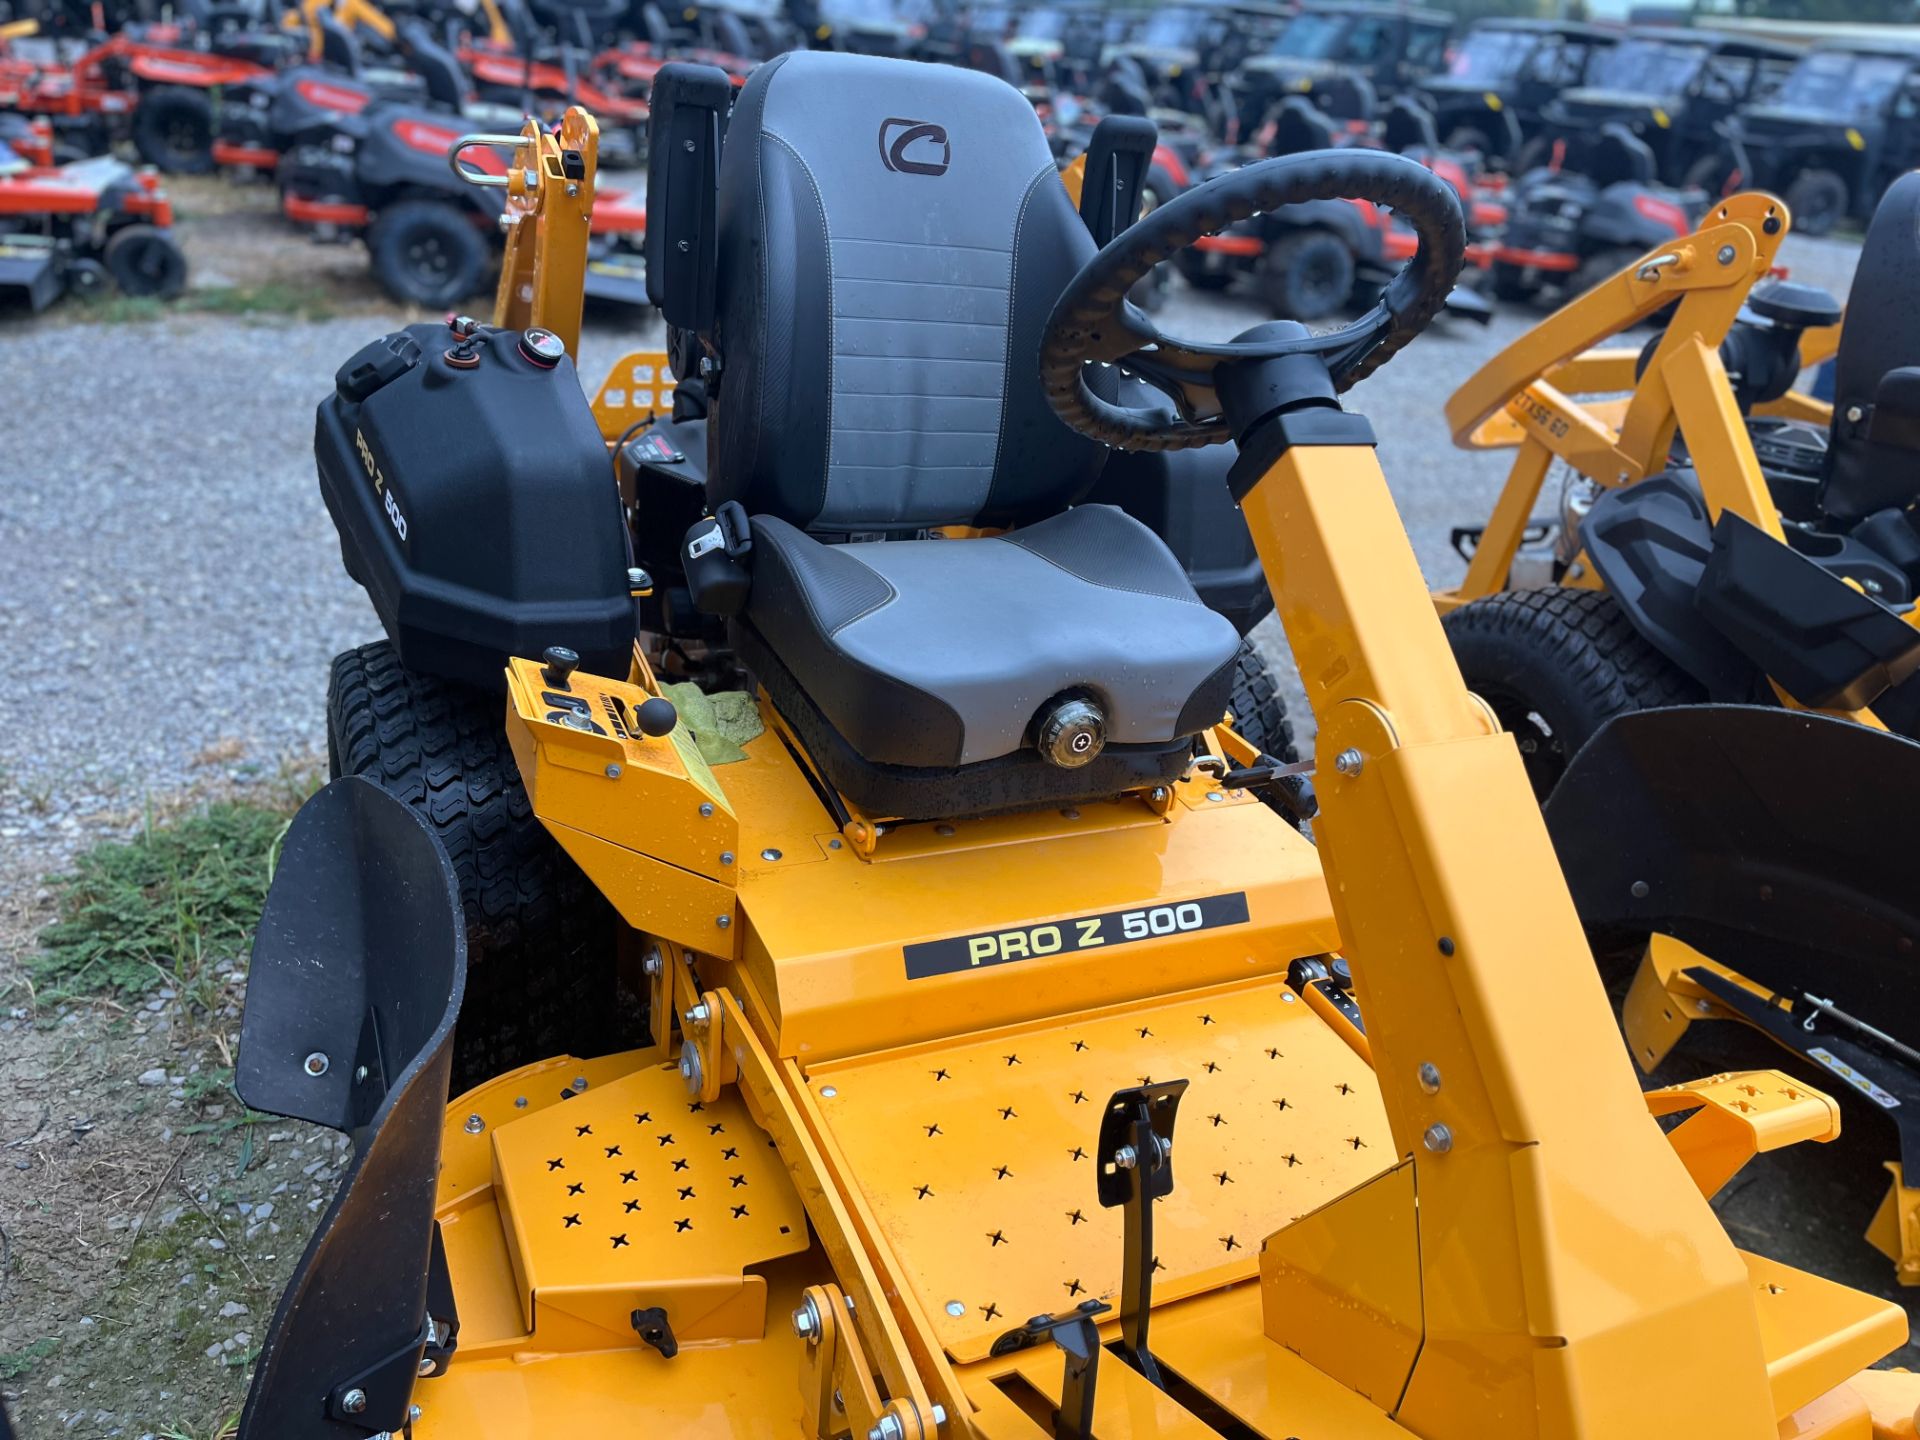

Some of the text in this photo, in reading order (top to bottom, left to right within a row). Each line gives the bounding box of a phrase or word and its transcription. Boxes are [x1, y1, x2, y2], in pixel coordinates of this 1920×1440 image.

[356, 427, 408, 542] PRO Z 500
[968, 903, 1204, 966] PRO Z 500
